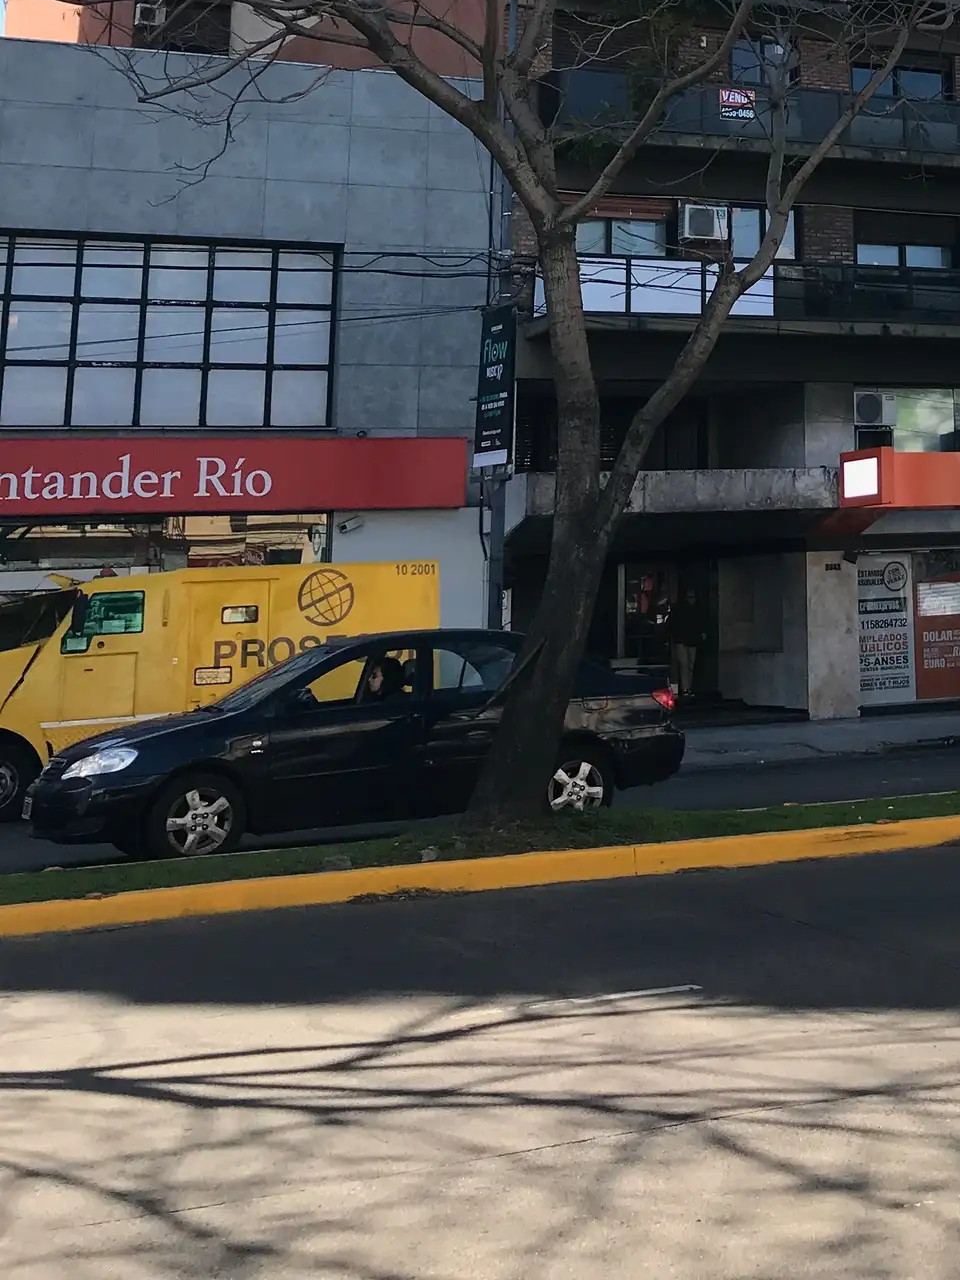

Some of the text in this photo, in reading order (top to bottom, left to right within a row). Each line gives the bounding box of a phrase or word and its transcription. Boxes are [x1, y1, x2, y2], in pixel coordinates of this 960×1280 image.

[483, 338, 508, 364] flow
[193, 457, 273, 497] Río
[395, 564, 437, 576] 10 2001
[860, 618, 908, 630] 1158264732
[923, 629, 953, 643] DOLAR
[923, 658, 946, 669] EURO
